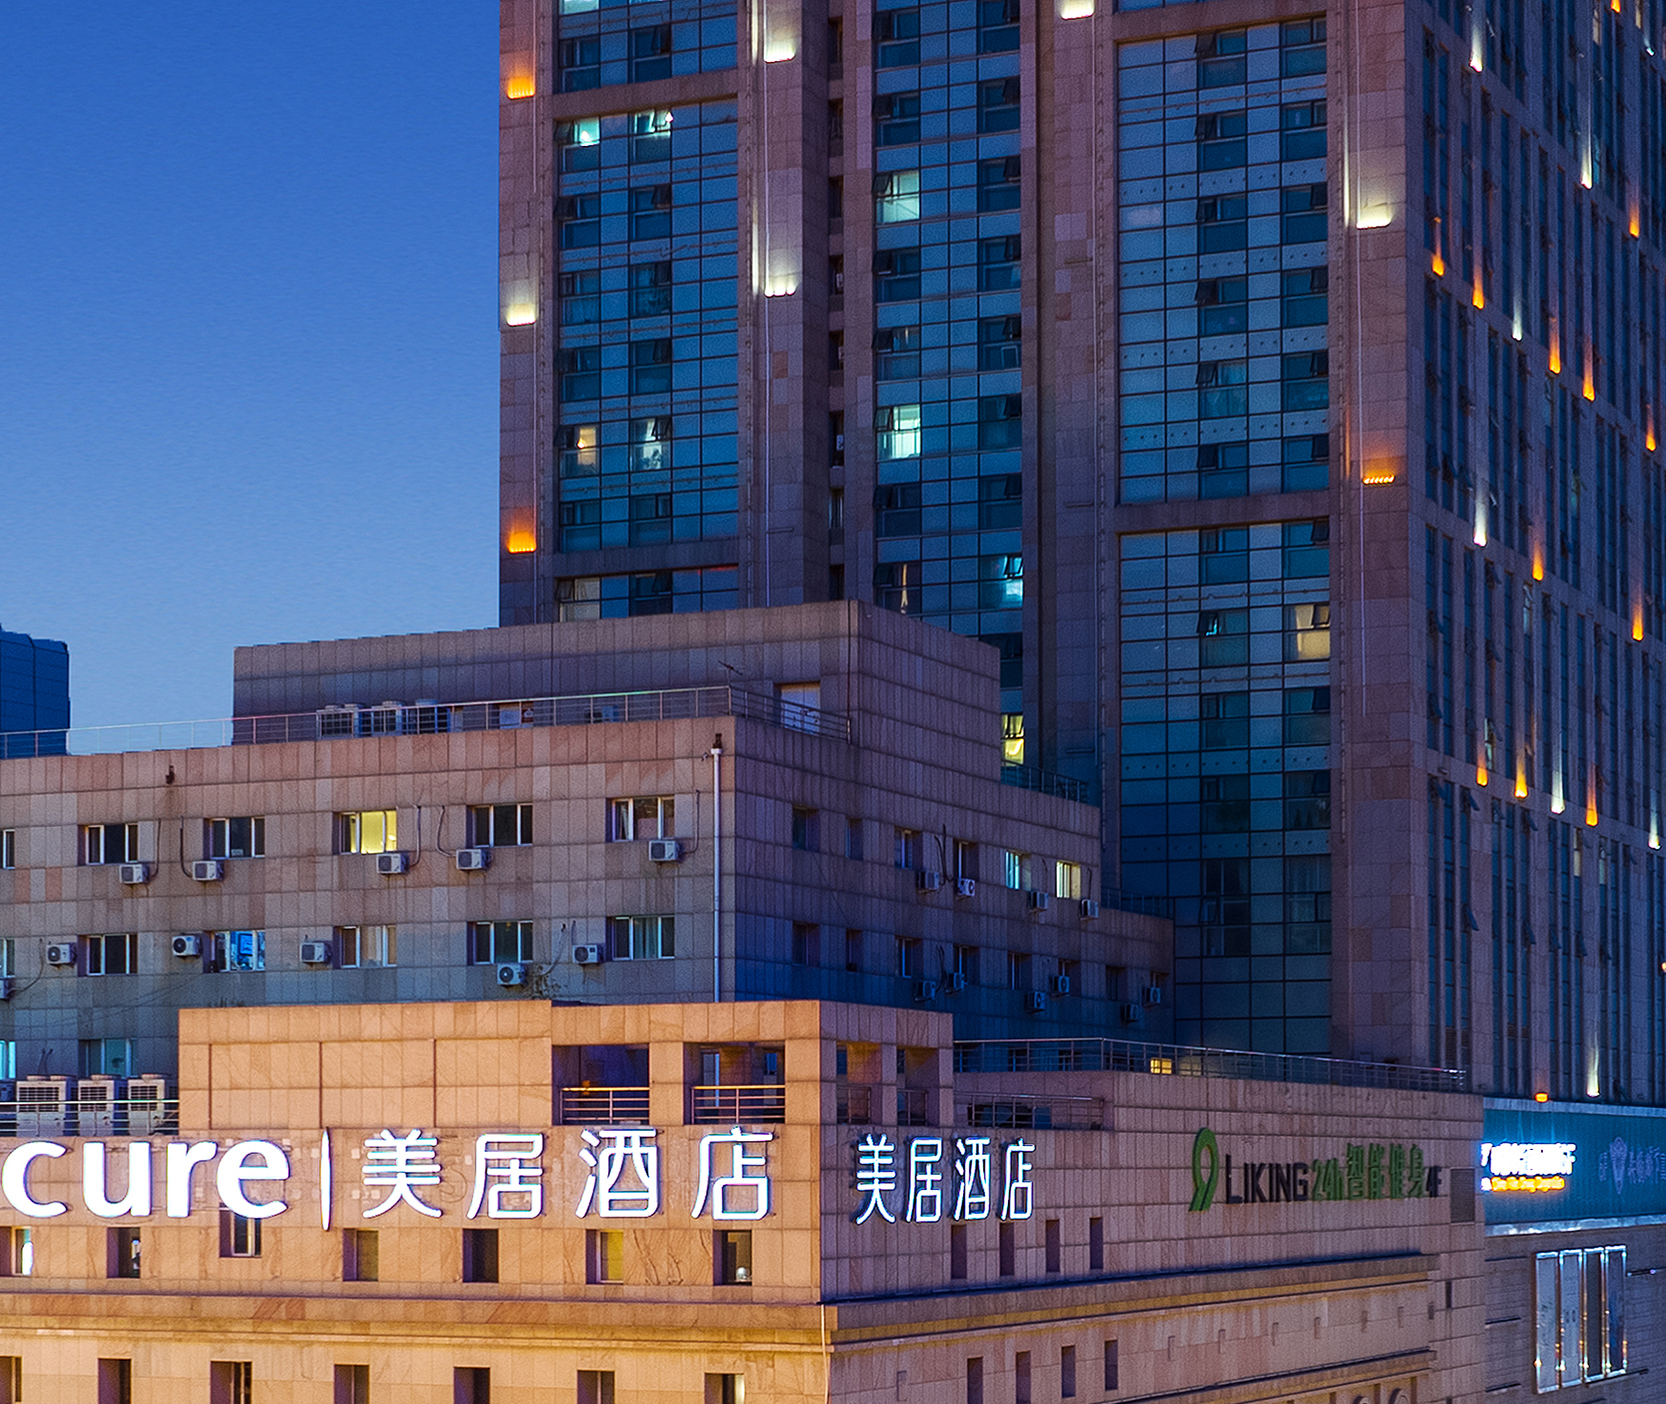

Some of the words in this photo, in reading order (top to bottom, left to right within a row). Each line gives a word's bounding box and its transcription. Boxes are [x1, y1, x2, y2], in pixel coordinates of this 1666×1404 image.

[361, 1127, 774, 1221] 美居酒店
[856, 1135, 1037, 1224] 美居酒店
